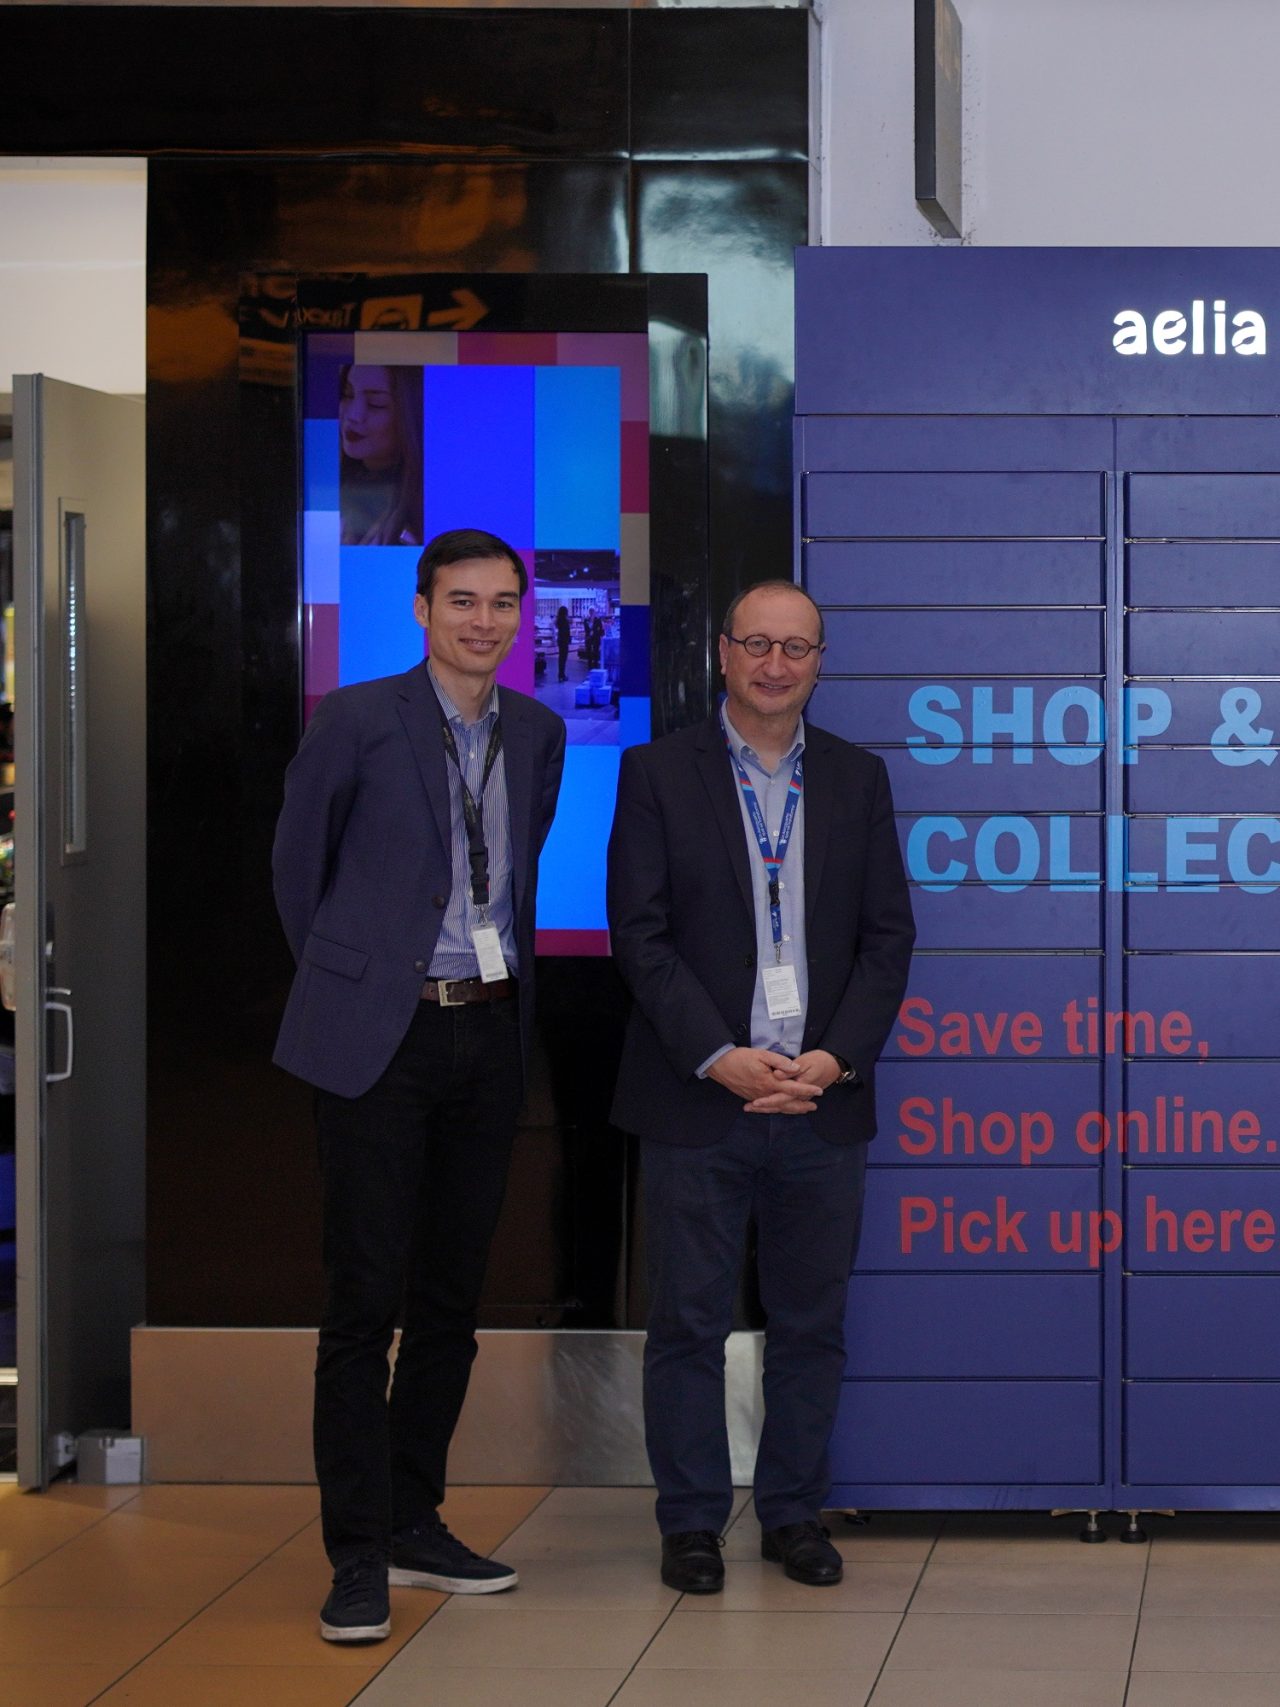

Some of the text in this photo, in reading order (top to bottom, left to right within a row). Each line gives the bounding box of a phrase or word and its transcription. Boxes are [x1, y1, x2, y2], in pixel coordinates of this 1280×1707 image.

[1112, 300, 1266, 355] aelia
[906, 685, 1279, 767] SHOP &
[896, 996, 1209, 1065] Save time,
[898, 1096, 1277, 1165] Shop online.
[900, 1196, 1028, 1254] Pick
[1049, 1210, 1124, 1268] up
